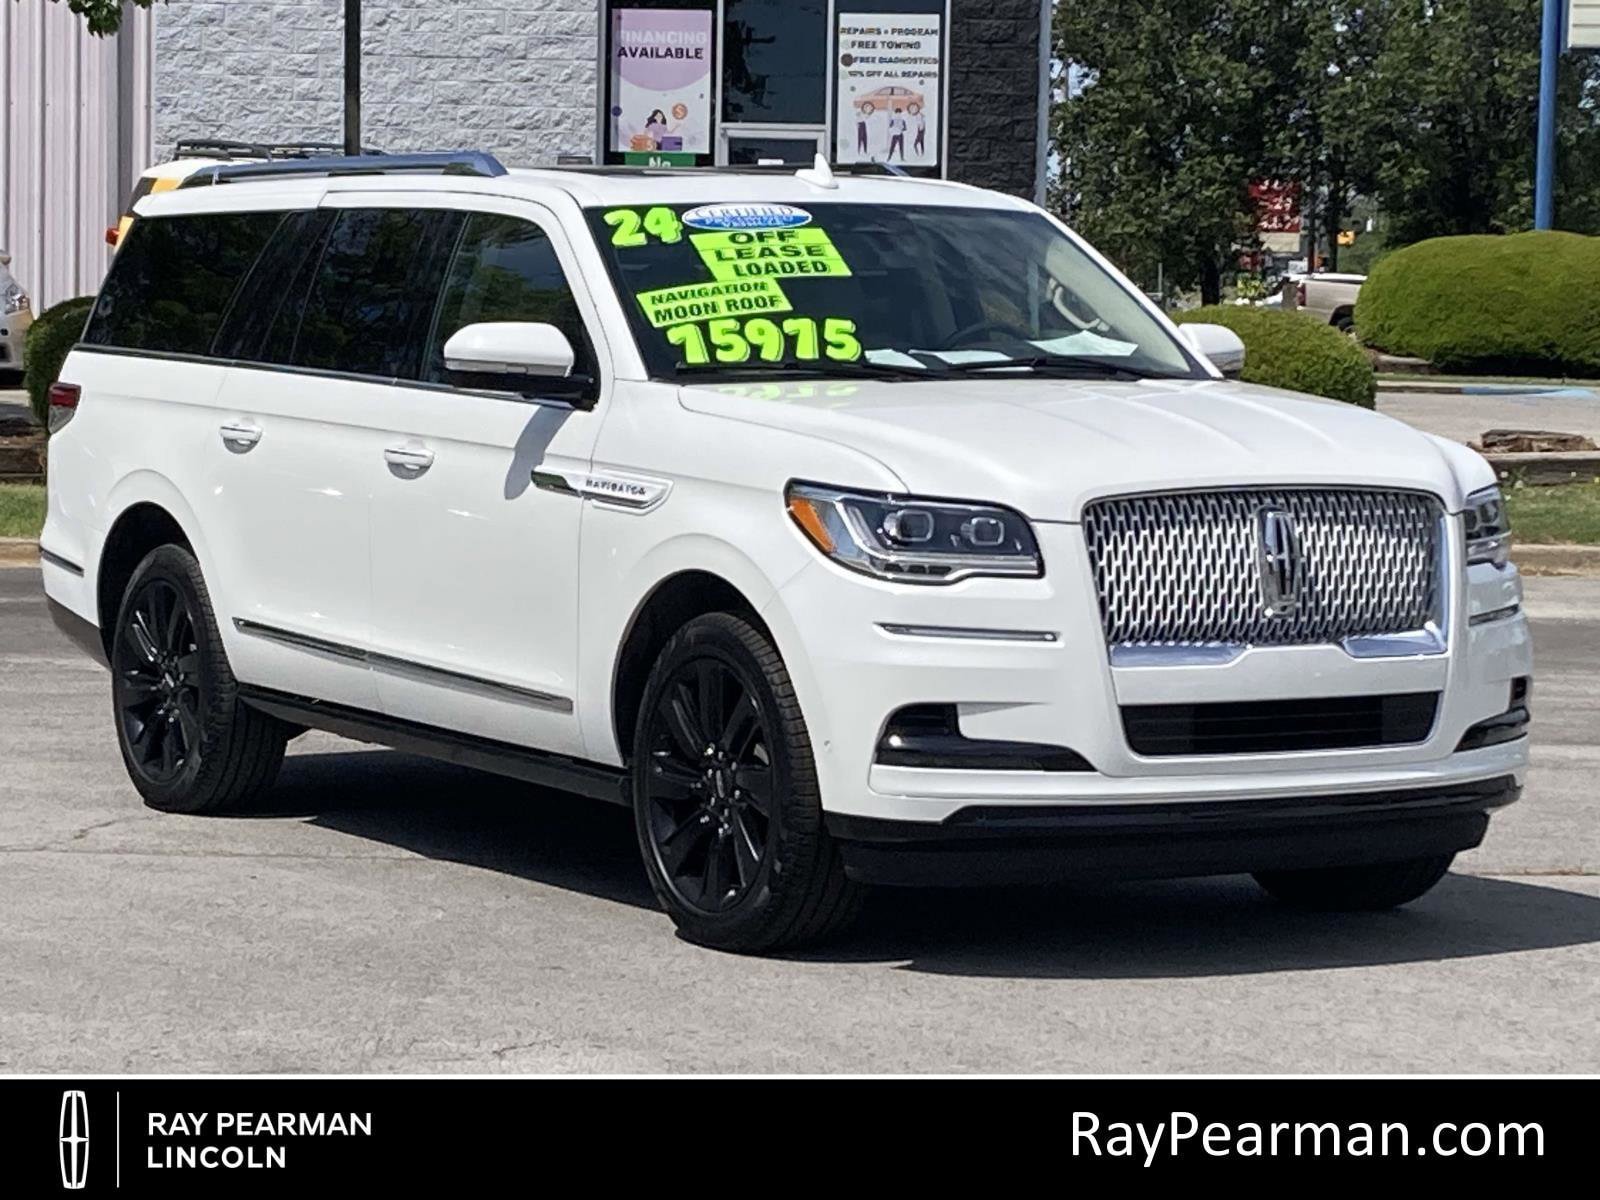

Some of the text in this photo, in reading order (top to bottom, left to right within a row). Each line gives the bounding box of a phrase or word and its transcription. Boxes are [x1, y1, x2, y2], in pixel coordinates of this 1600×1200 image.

[617, 46, 704, 60] AVAILABLE
[851, 41, 921, 49] FREE TOWING
[853, 56, 877, 65] FREE
[884, 70, 899, 78] ALL
[603, 206, 684, 247] 24
[727, 230, 800, 246] OFF
[713, 245, 828, 262] LEASE
[732, 261, 830, 278] LOADED
[650, 280, 769, 306] NAVIGATION
[654, 296, 782, 324] MOON ROOF
[666, 318, 862, 364] 75975
